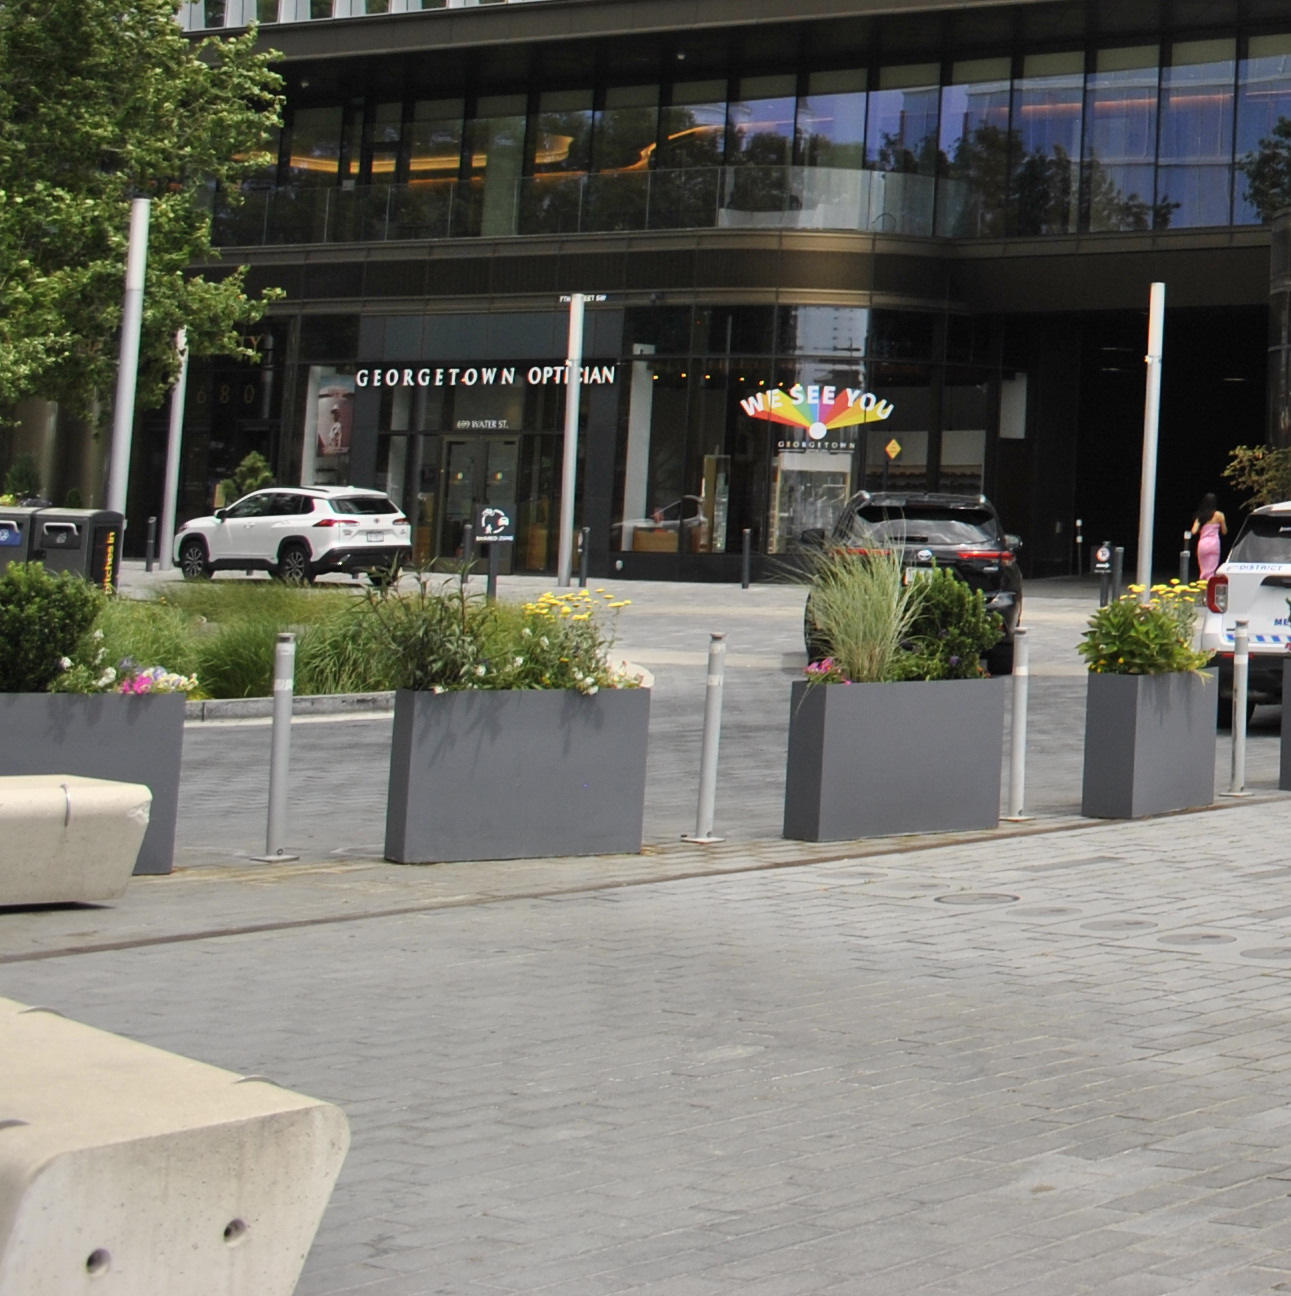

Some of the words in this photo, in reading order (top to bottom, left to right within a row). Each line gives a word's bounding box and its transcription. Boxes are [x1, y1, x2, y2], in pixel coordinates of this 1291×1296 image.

[356, 367, 515, 387] GEORGETOWN
[740, 388, 783, 416] WE
[790, 385, 836, 405] SEE
[846, 387, 895, 419] YOU
[471, 419, 497, 429] WATER
[778, 441, 855, 449] GEORGETOWN
